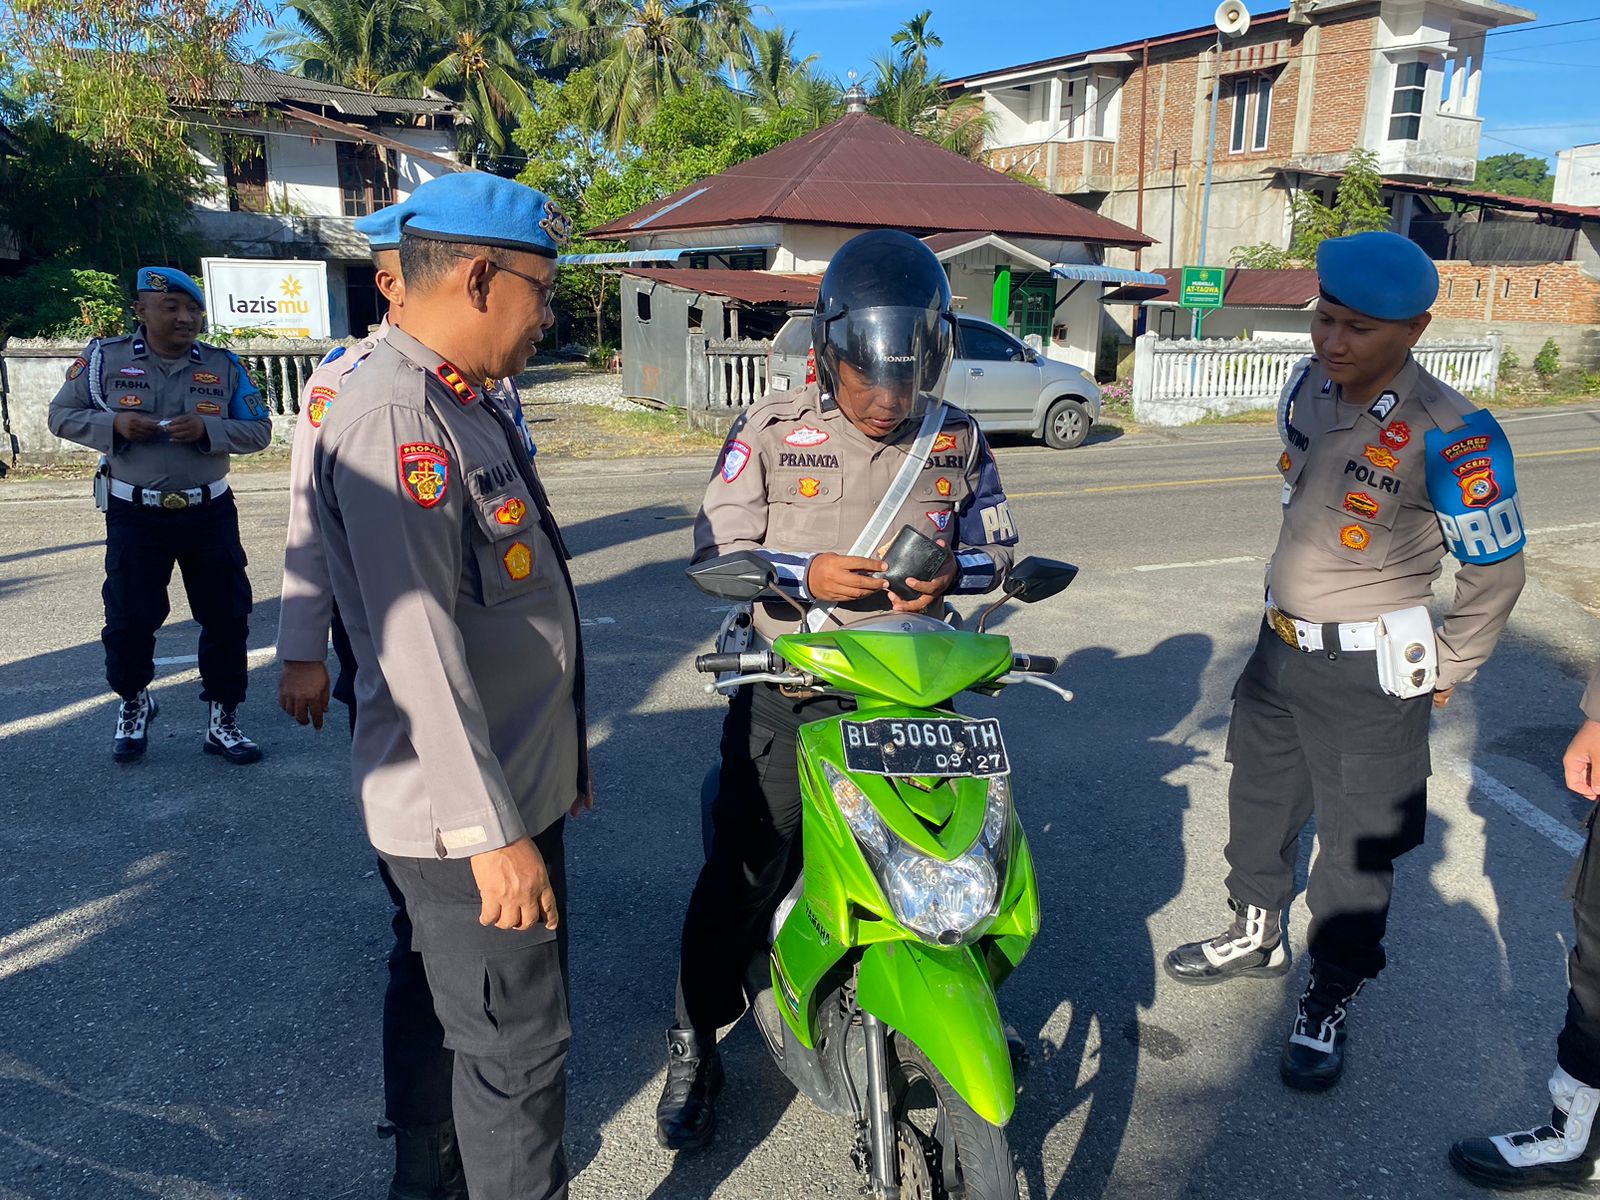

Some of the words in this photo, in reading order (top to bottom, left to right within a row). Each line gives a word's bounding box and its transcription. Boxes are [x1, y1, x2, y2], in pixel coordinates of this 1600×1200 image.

[228, 293, 310, 314] lazismu
[115, 379, 150, 390] FASHA
[189, 386, 225, 397] POLRI
[403, 445, 444, 456] PROPAM
[1444, 437, 1488, 456] POLRES
[779, 452, 839, 468] PRANATA
[922, 455, 963, 470] OLRI
[1458, 459, 1486, 474] ACEH
[1343, 459, 1401, 495] POLRI
[980, 500, 1018, 544] PA
[1435, 497, 1522, 556] PRO
[847, 725, 879, 747] BL
[891, 723, 952, 746] 5060
[963, 724, 998, 748] TH
[806, 906, 830, 944] YAMAHA
